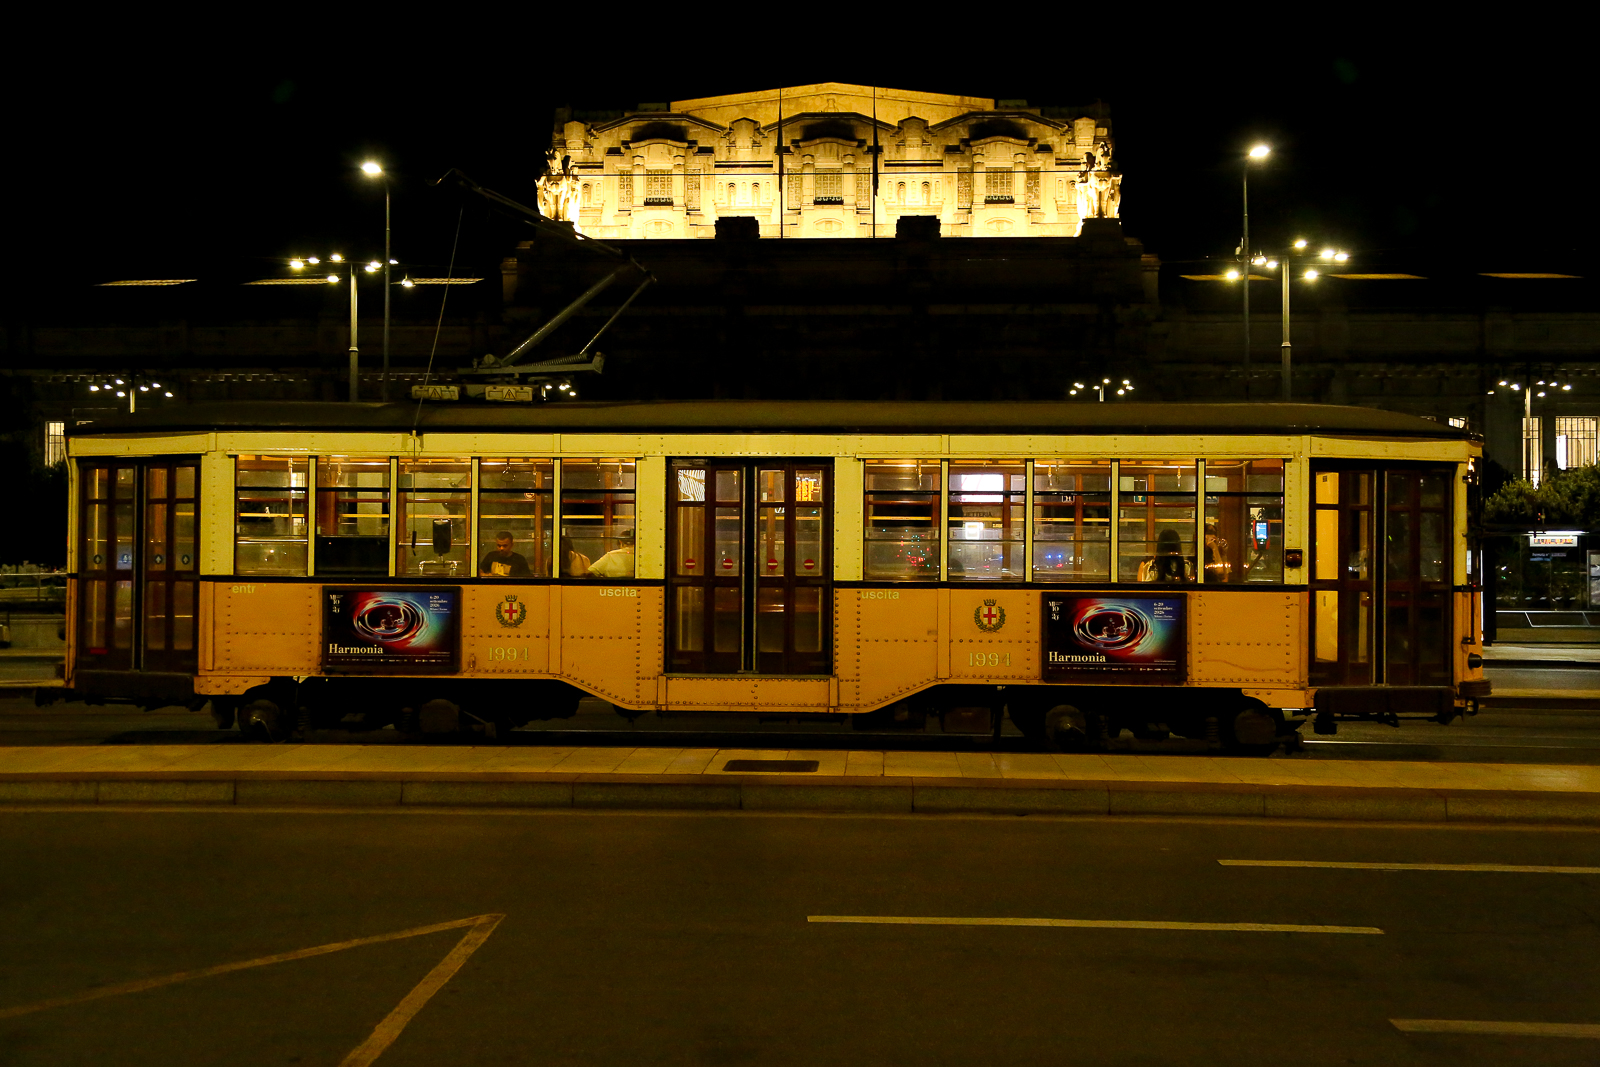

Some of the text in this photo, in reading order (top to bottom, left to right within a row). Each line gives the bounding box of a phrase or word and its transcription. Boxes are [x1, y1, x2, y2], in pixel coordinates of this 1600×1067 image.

[599, 587, 637, 597] uscita
[861, 589, 900, 600] uscita
[328, 643, 384, 655] Harmonia
[488, 647, 529, 661] 1994
[969, 652, 1011, 667] 1994
[1048, 651, 1107, 663] Harmonia
